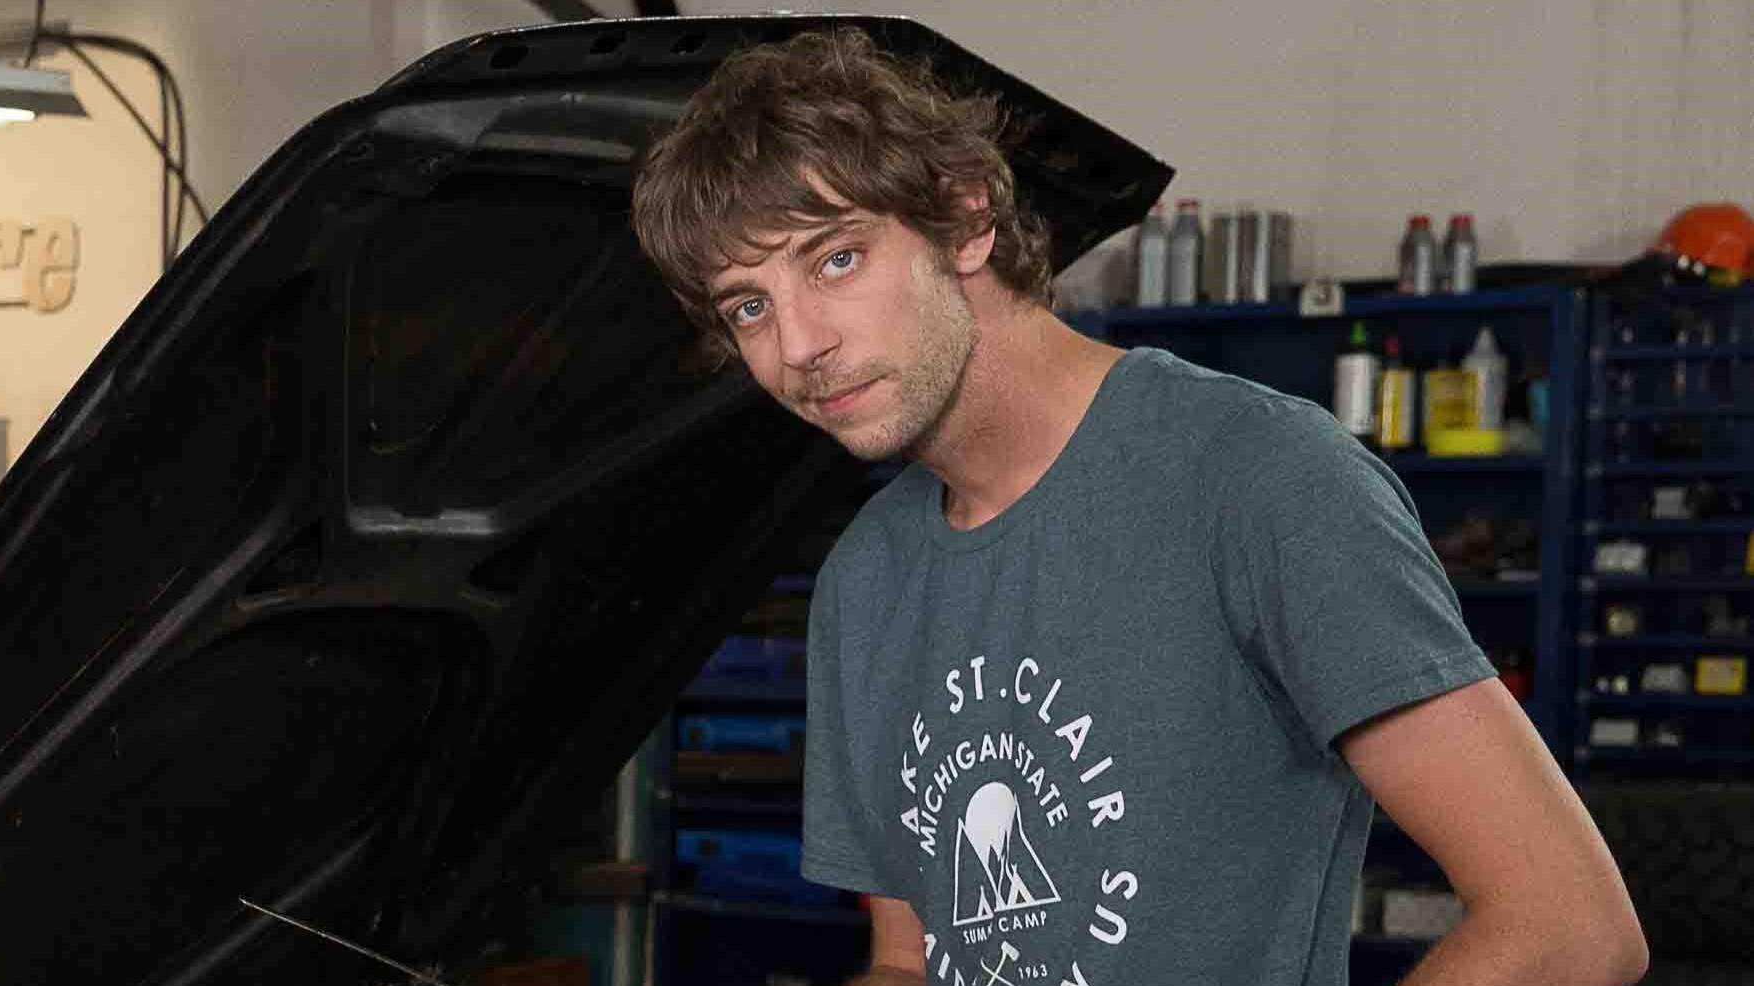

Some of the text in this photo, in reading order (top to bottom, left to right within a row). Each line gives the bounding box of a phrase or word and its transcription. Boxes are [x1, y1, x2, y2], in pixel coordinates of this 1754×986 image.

[901, 711, 931, 836] AKE
[998, 911, 1047, 932] CAMP
[1088, 868, 1139, 945] US
[1018, 964, 1048, 979] 1963
